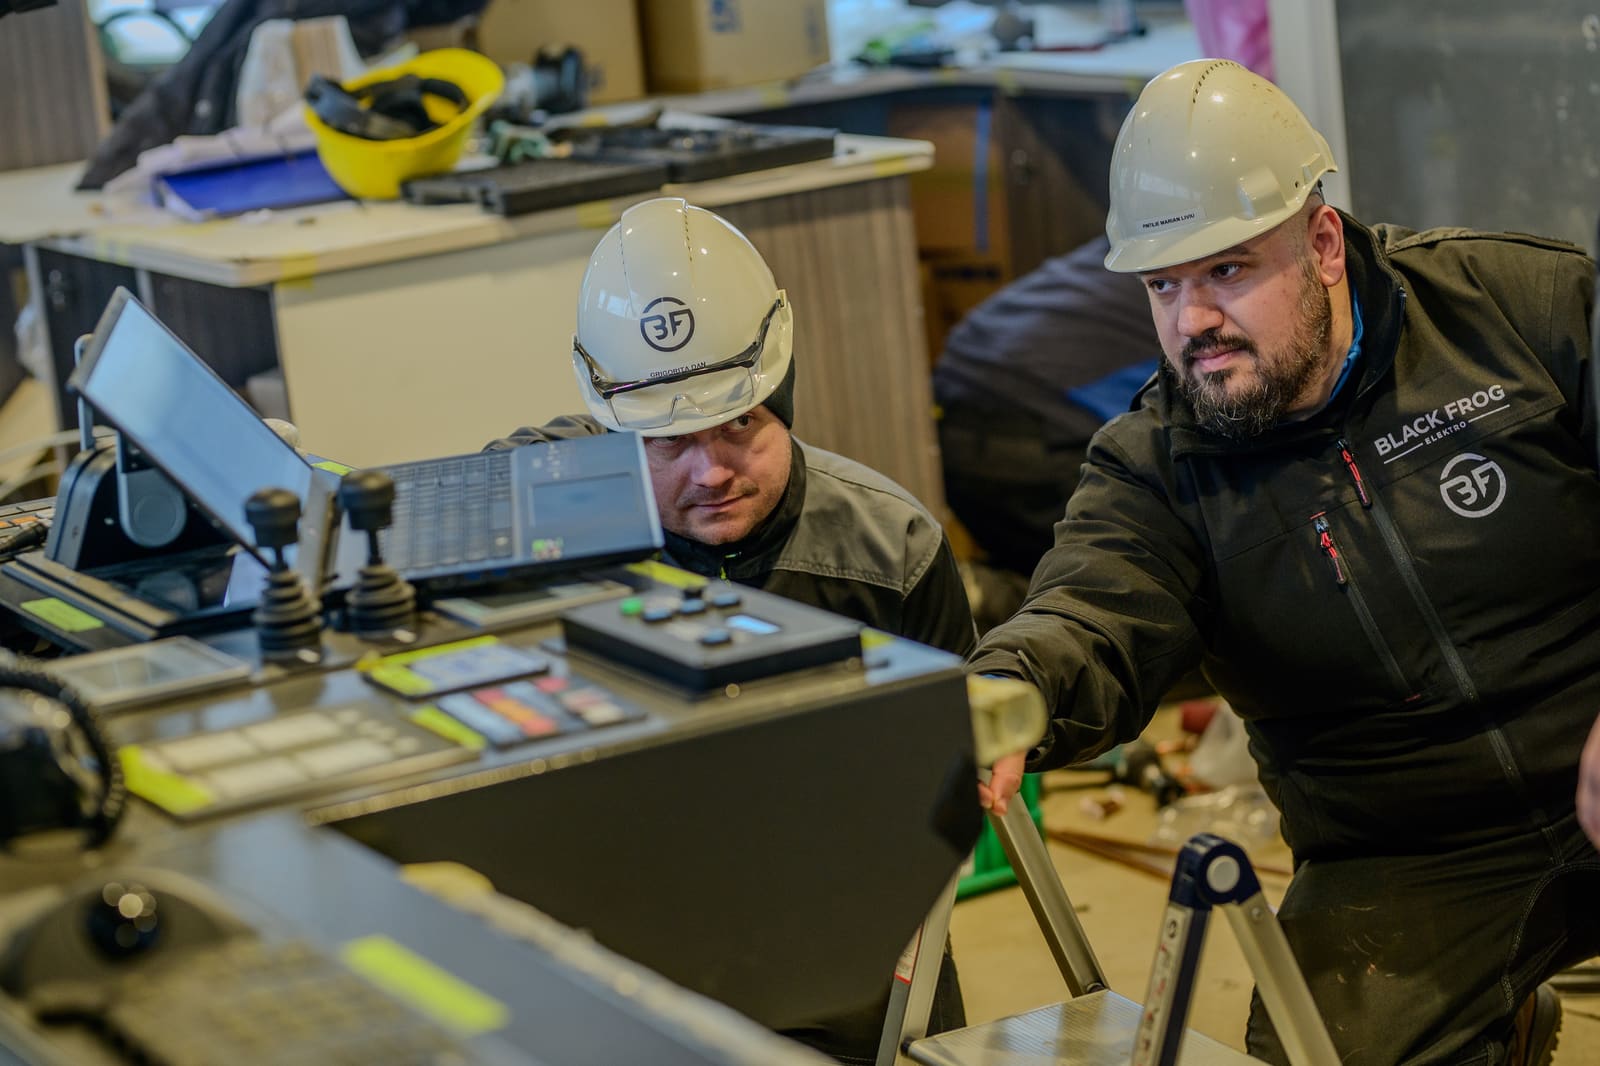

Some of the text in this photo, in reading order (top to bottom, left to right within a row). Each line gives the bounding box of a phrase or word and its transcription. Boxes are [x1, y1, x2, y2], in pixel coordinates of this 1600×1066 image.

[691, 361, 706, 371] DAN
[1374, 384, 1506, 456] BLACK FROG
[1424, 421, 1467, 445] ELEKTRO
